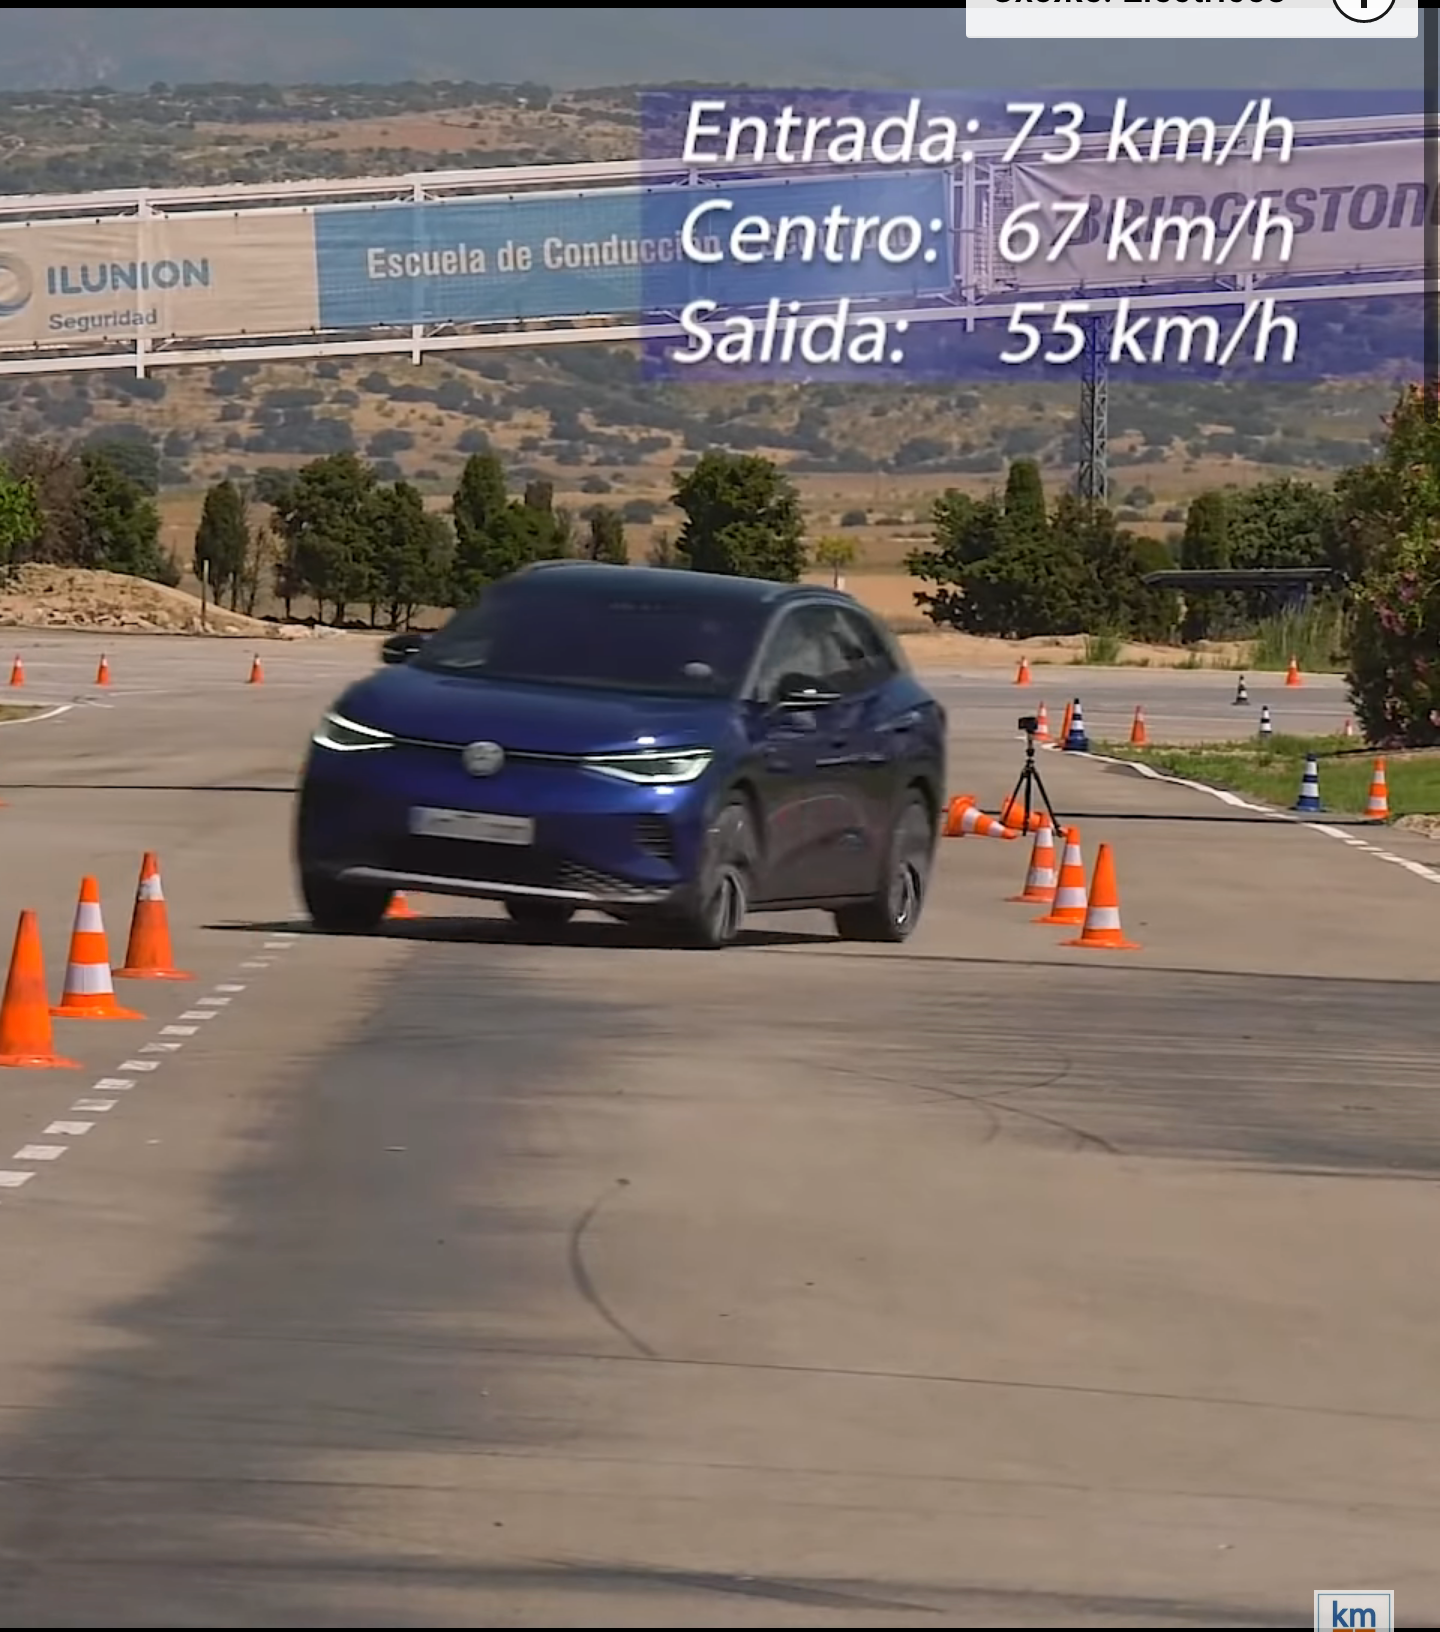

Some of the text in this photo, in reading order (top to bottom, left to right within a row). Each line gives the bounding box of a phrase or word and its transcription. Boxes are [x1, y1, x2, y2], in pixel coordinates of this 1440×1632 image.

[47, 259, 210, 295] ILUNION
[367, 243, 486, 279] Escuela
[497, 240, 532, 272] de
[49, 309, 158, 333] Seguridad
